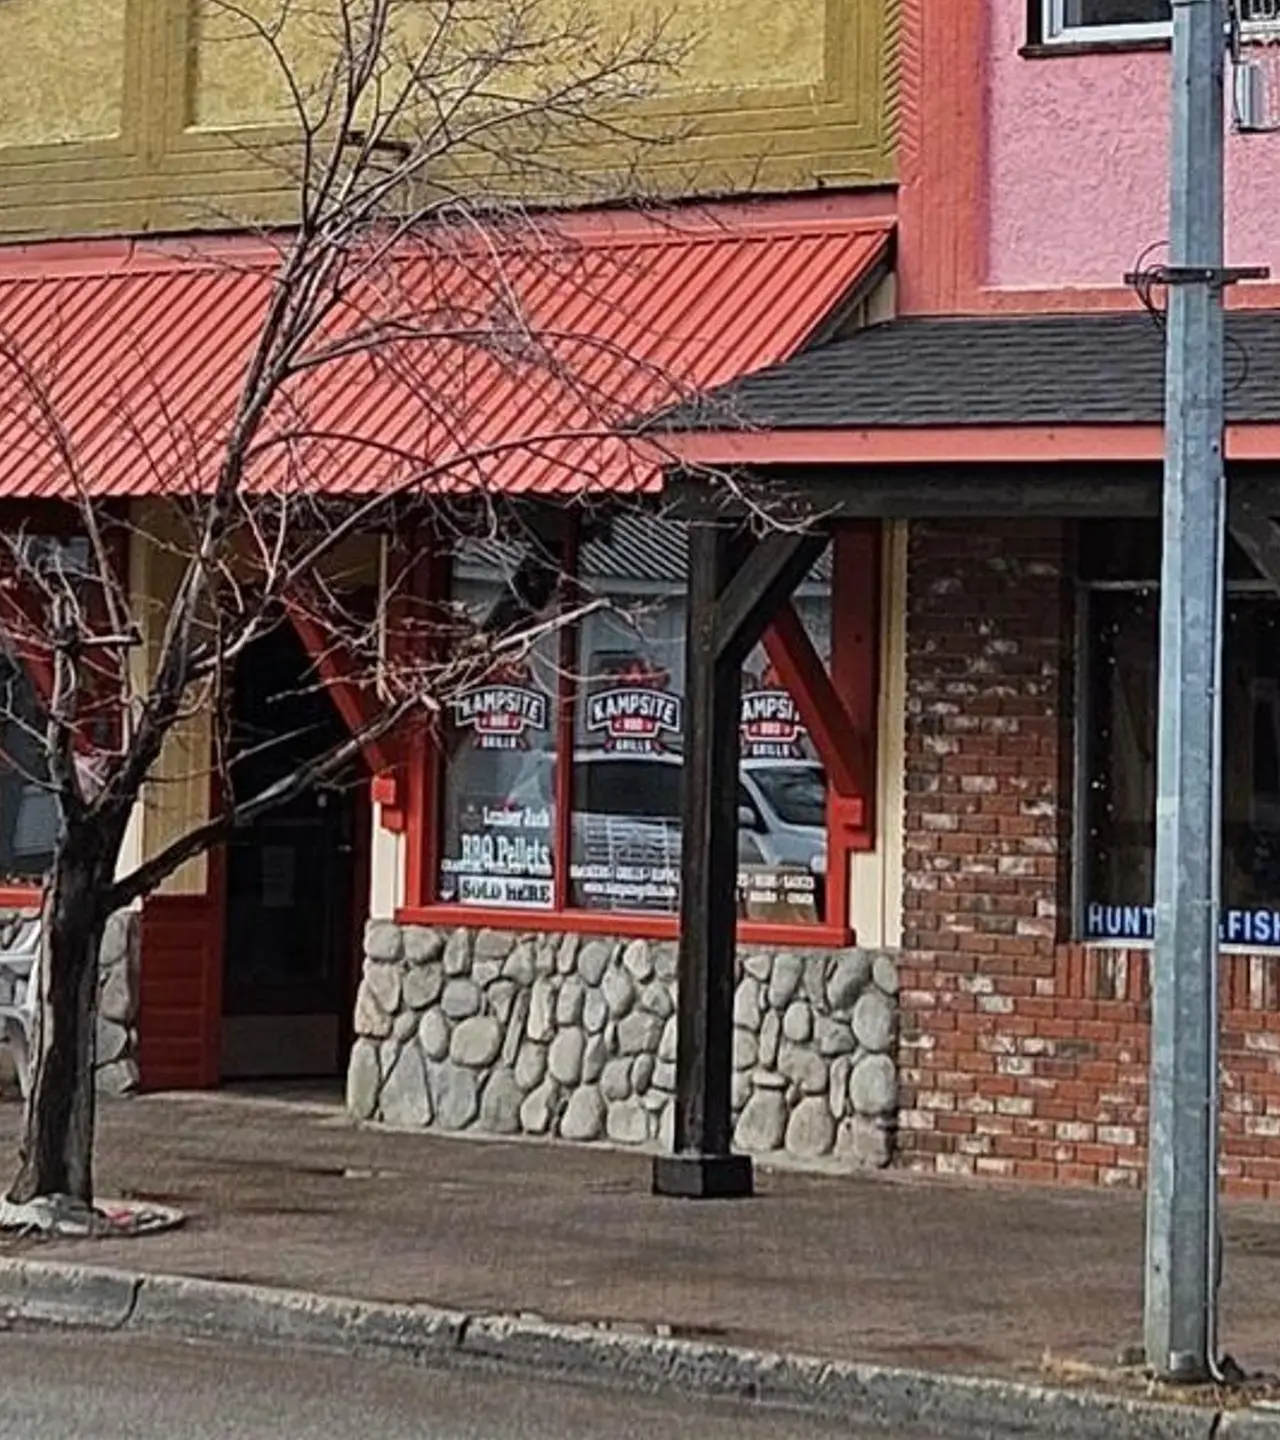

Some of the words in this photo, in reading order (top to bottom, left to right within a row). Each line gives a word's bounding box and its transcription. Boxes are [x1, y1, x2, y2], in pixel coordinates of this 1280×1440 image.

[463, 691, 539, 721] KAMPSITE
[594, 693, 675, 724] KAMPSITE
[741, 697, 800, 722] AMPSI
[497, 834, 551, 866] Pellets
[462, 879, 501, 899] SOLD
[505, 882, 551, 903] HERE
